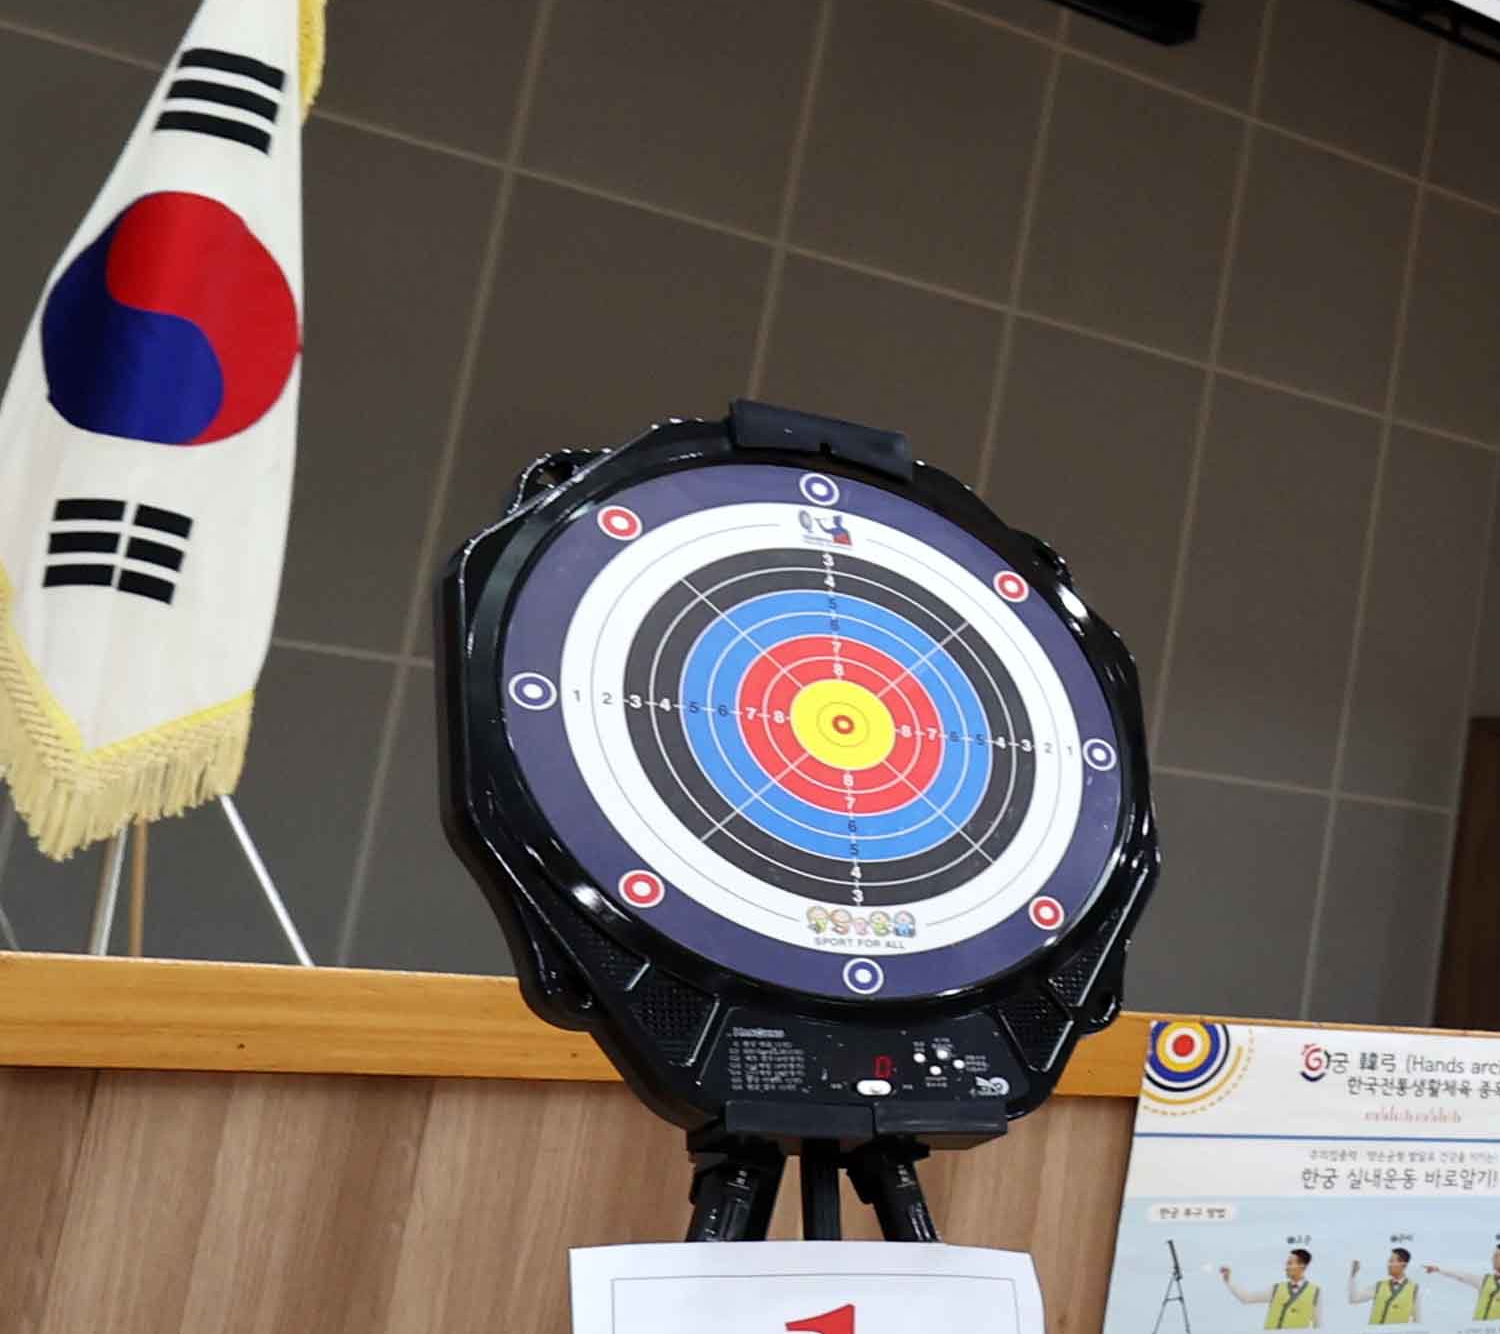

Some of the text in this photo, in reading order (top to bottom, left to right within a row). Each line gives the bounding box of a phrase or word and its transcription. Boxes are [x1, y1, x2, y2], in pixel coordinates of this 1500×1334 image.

[814, 936, 906, 949] SPORT FOR ALL
[1405, 1054, 1465, 1075] (Hands
[1301, 1168, 1499, 1190] 한궁 실내운동 바로알기!
